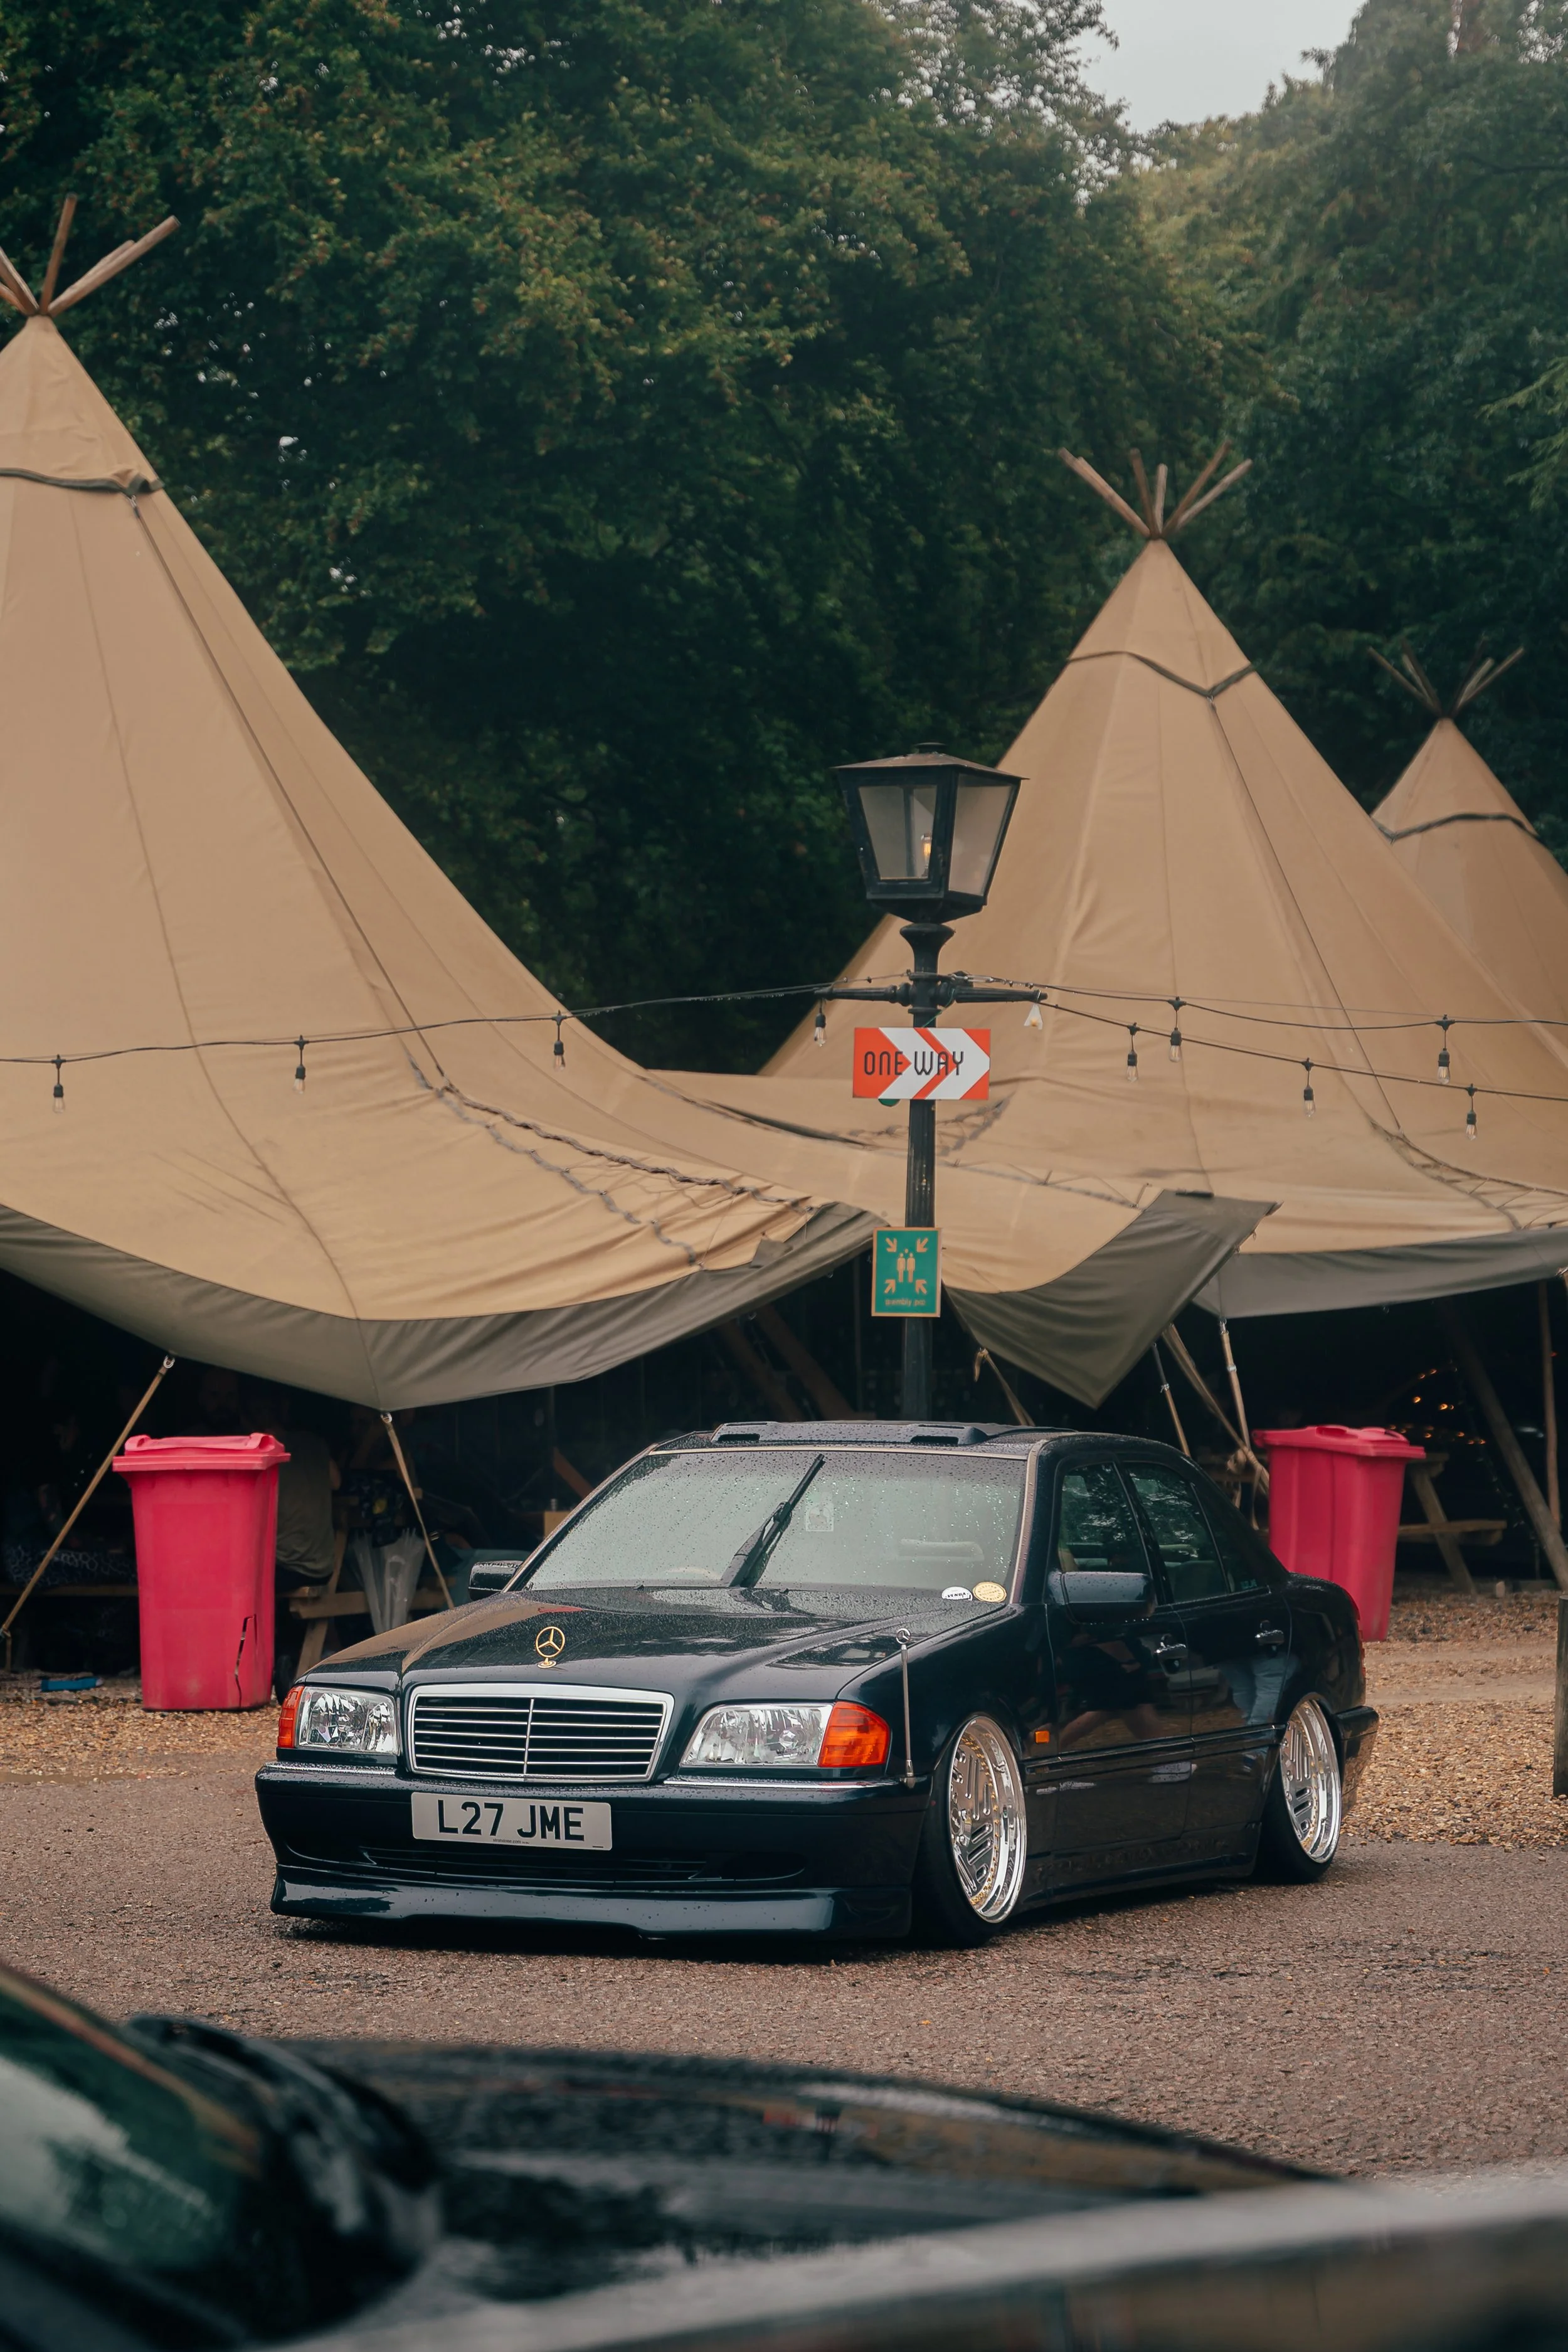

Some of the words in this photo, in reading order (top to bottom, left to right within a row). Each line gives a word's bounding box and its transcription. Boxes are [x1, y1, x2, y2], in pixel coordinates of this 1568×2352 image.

[864, 1051, 903, 1076] ONE
[914, 1051, 964, 1076] WAY
[438, 1799, 504, 1836] L27
[516, 1804, 585, 1841] JME
